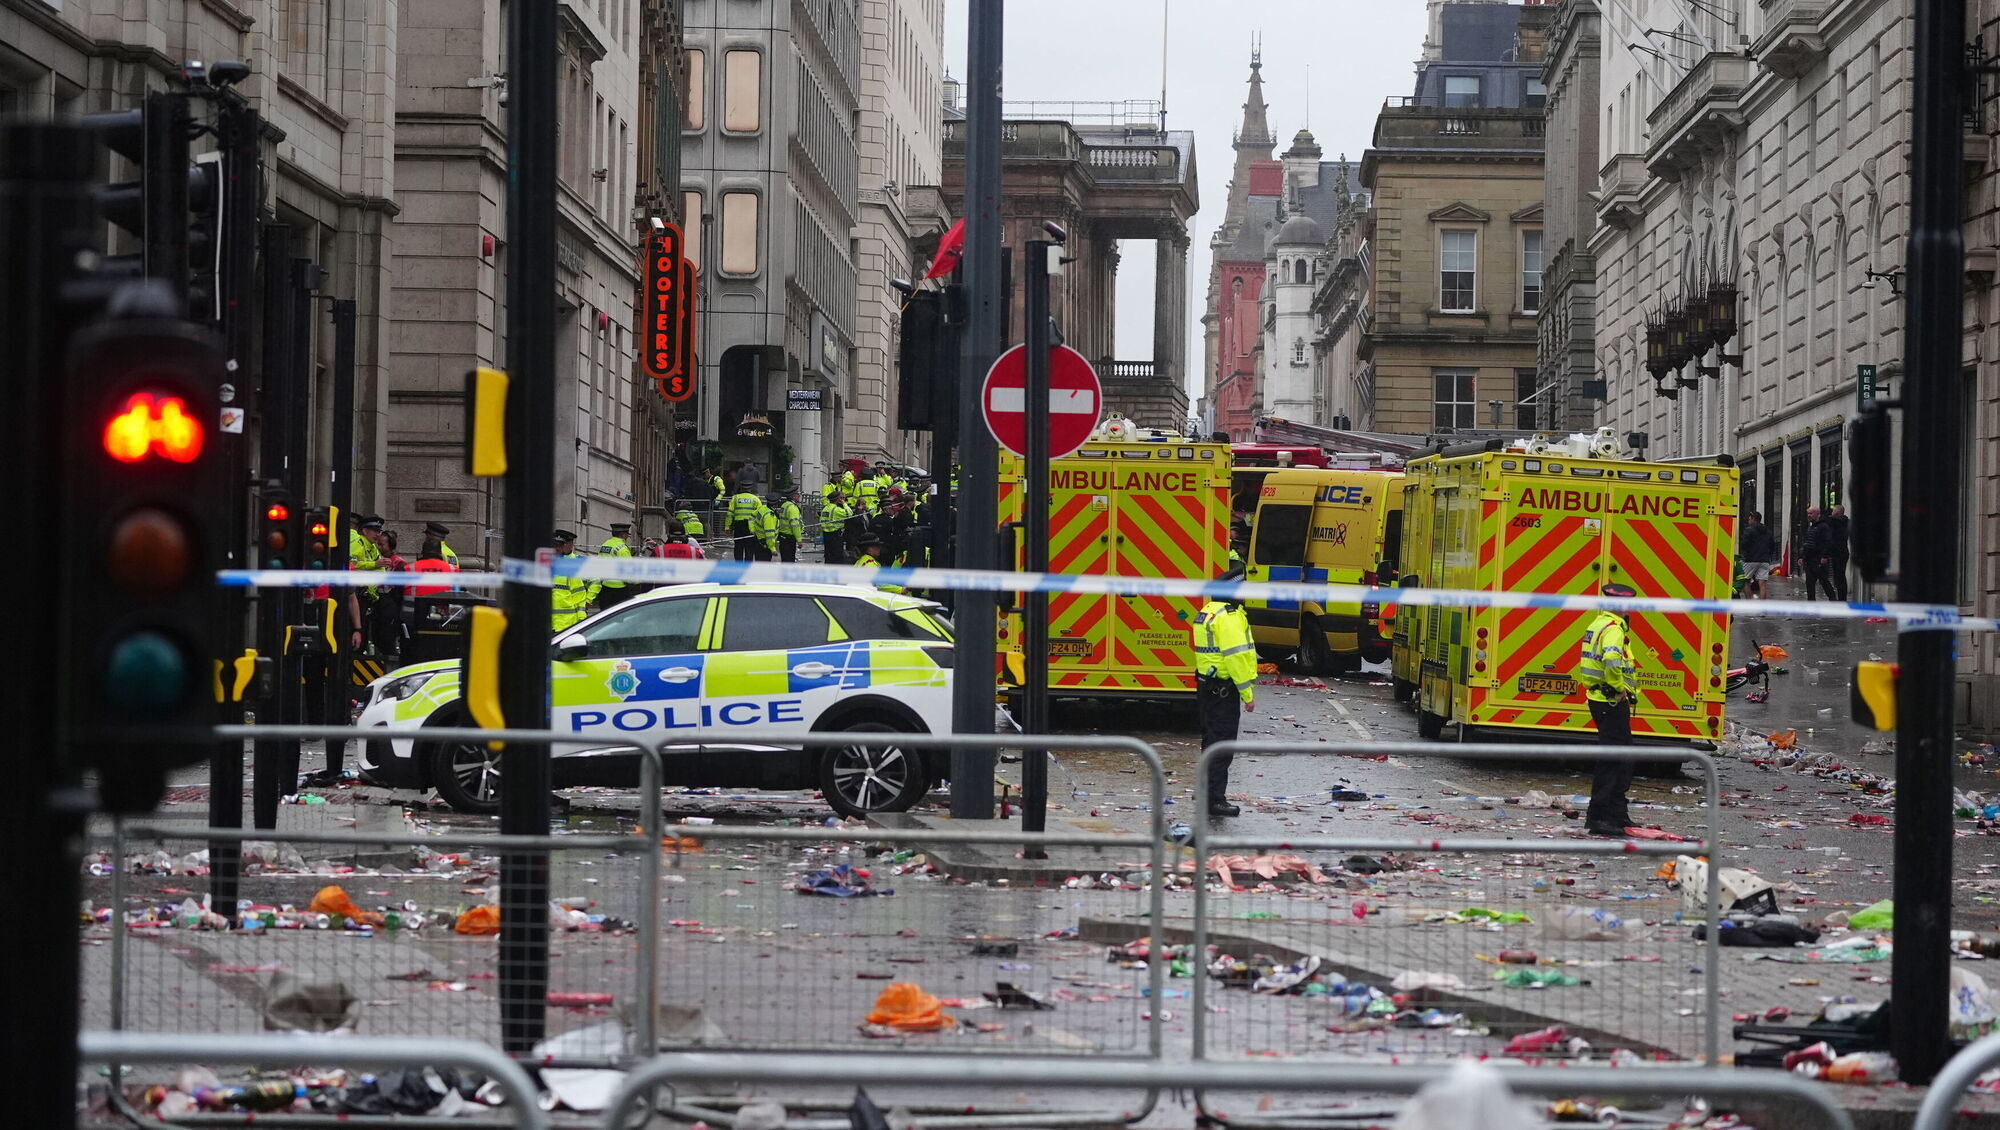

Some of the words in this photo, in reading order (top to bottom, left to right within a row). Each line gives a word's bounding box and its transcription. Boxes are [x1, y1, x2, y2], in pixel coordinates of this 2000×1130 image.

[655, 236, 672, 370] HOOTERS
[1863, 369, 1872, 405] MERS
[788, 401, 809, 410] CHARCOAL
[809, 401, 821, 410] GRILL
[1051, 470, 1197, 492] MBULANCE
[1315, 485, 1363, 504] ICE
[1518, 487, 1700, 519] AMBULANCE
[1512, 516, 1541, 529] Z603
[1525, 678, 1552, 690] DF24
[1555, 680, 1576, 692] OHX
[571, 699, 804, 734] POLICE
